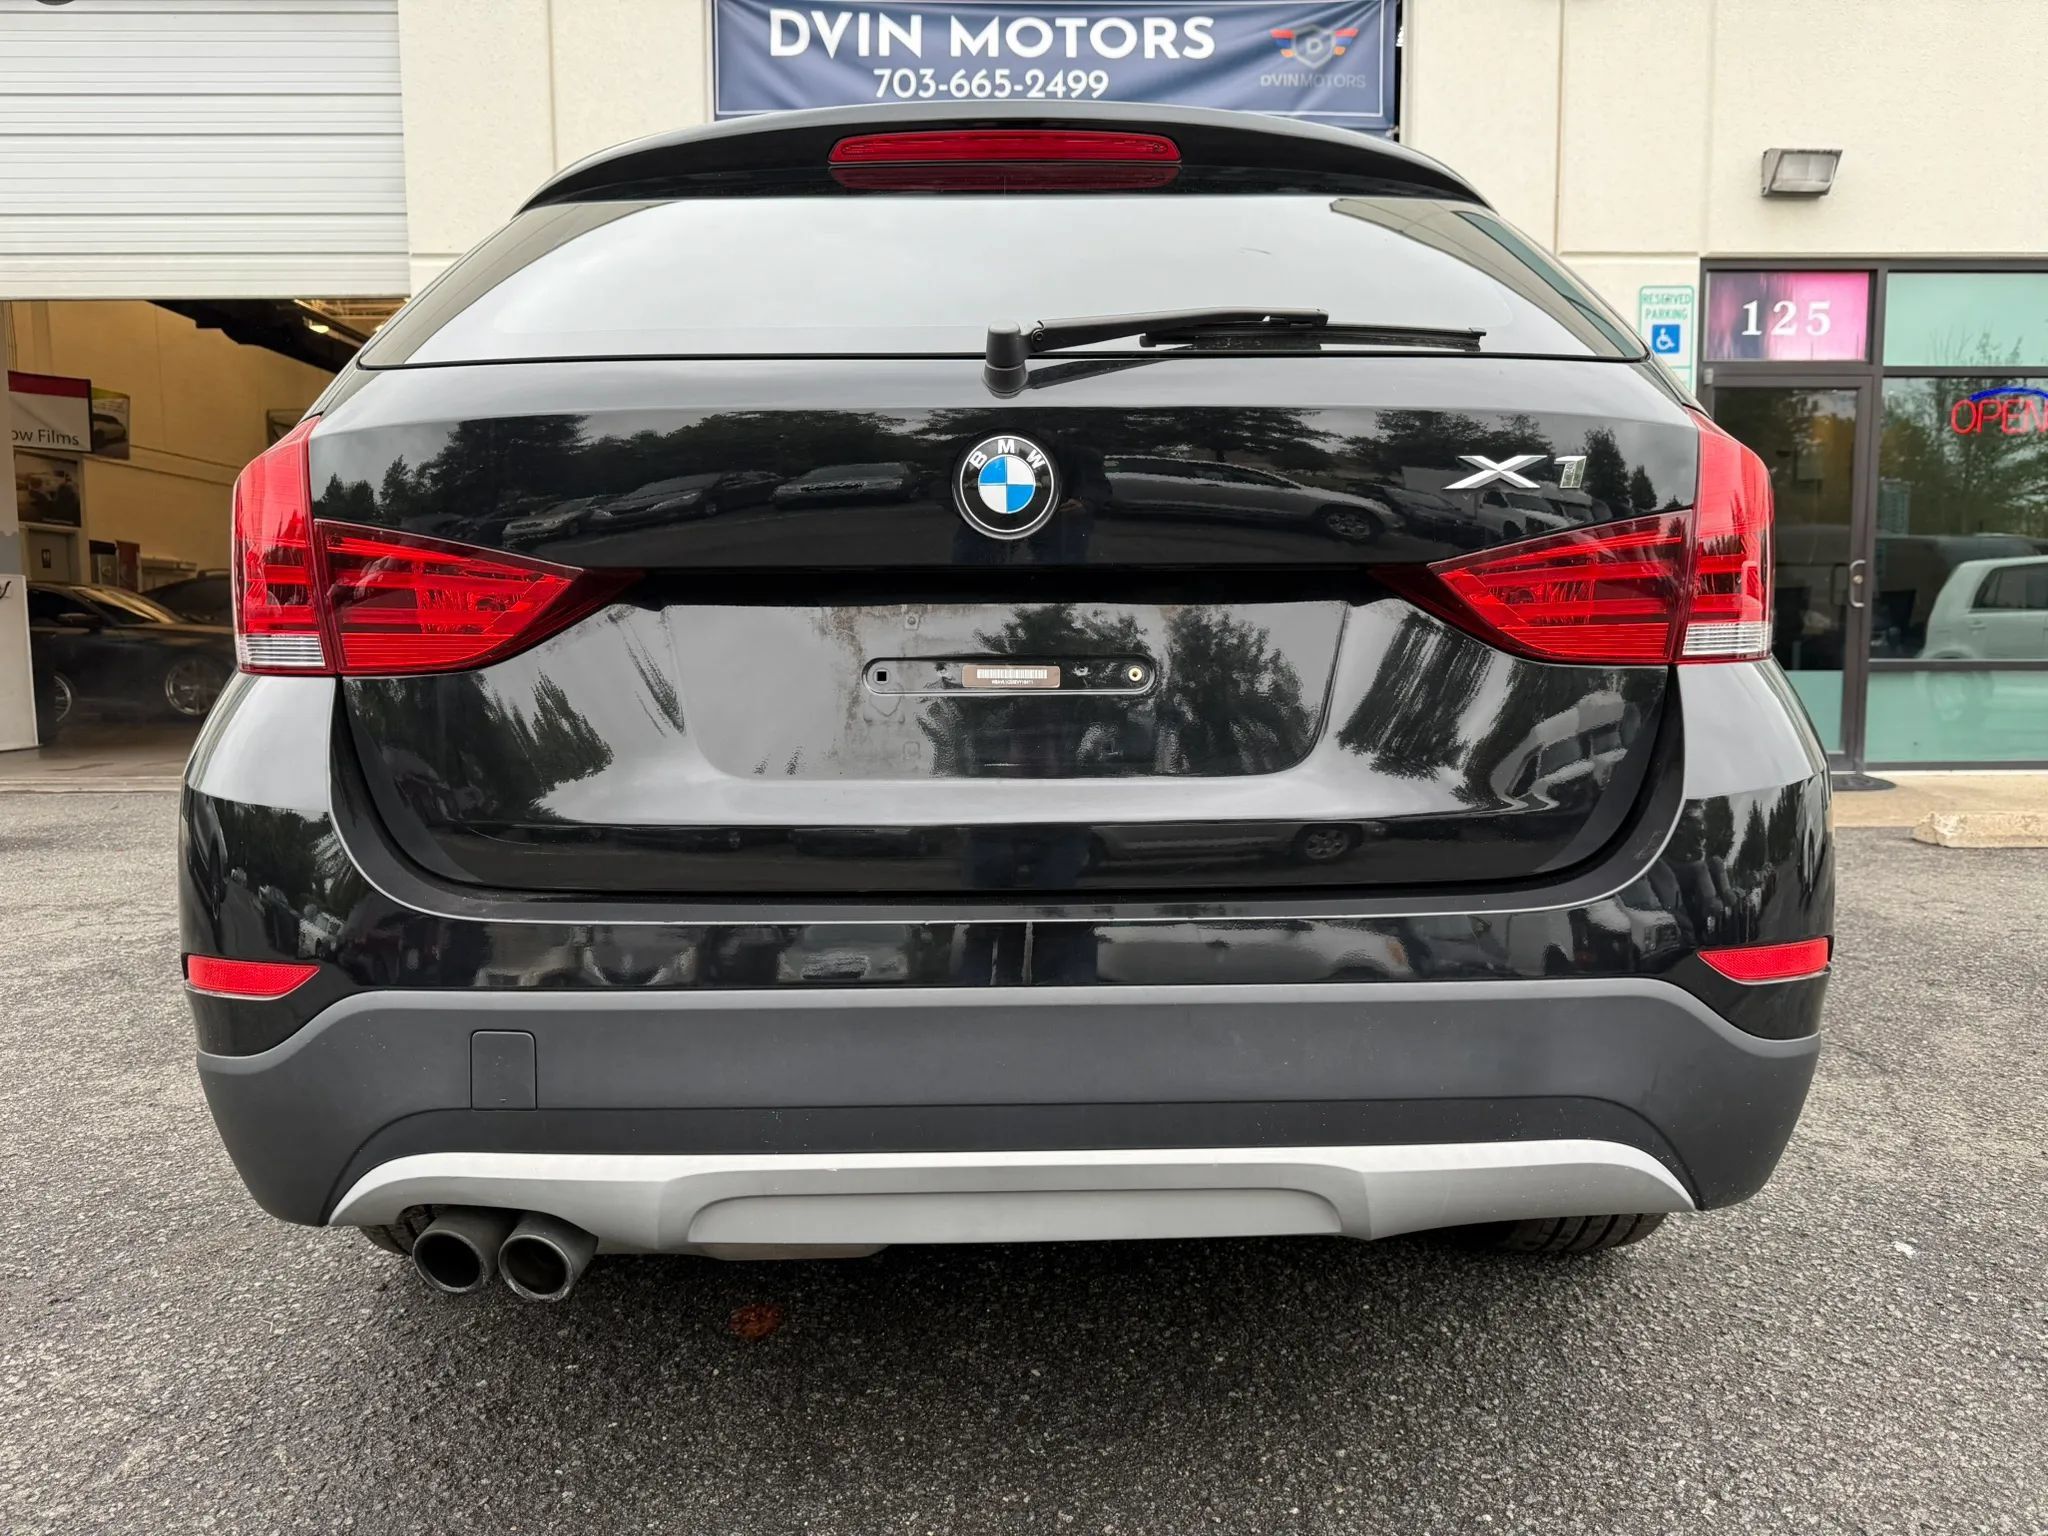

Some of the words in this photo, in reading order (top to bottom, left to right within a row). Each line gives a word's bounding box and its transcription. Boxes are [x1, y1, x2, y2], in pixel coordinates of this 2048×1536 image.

[769, 8, 922, 59] DVIN
[950, 15, 1215, 59] MOTORS
[873, 68, 1109, 98] 703-665-2499
[1641, 293, 1692, 304] RESERVED
[1645, 308, 1688, 320] PARKING
[1741, 299, 1831, 336] 125
[1951, 398, 2048, 434] OPEN
[38, 429, 80, 446] Films
[968, 439, 1046, 470] BMW
[1441, 454, 1588, 490] X1
